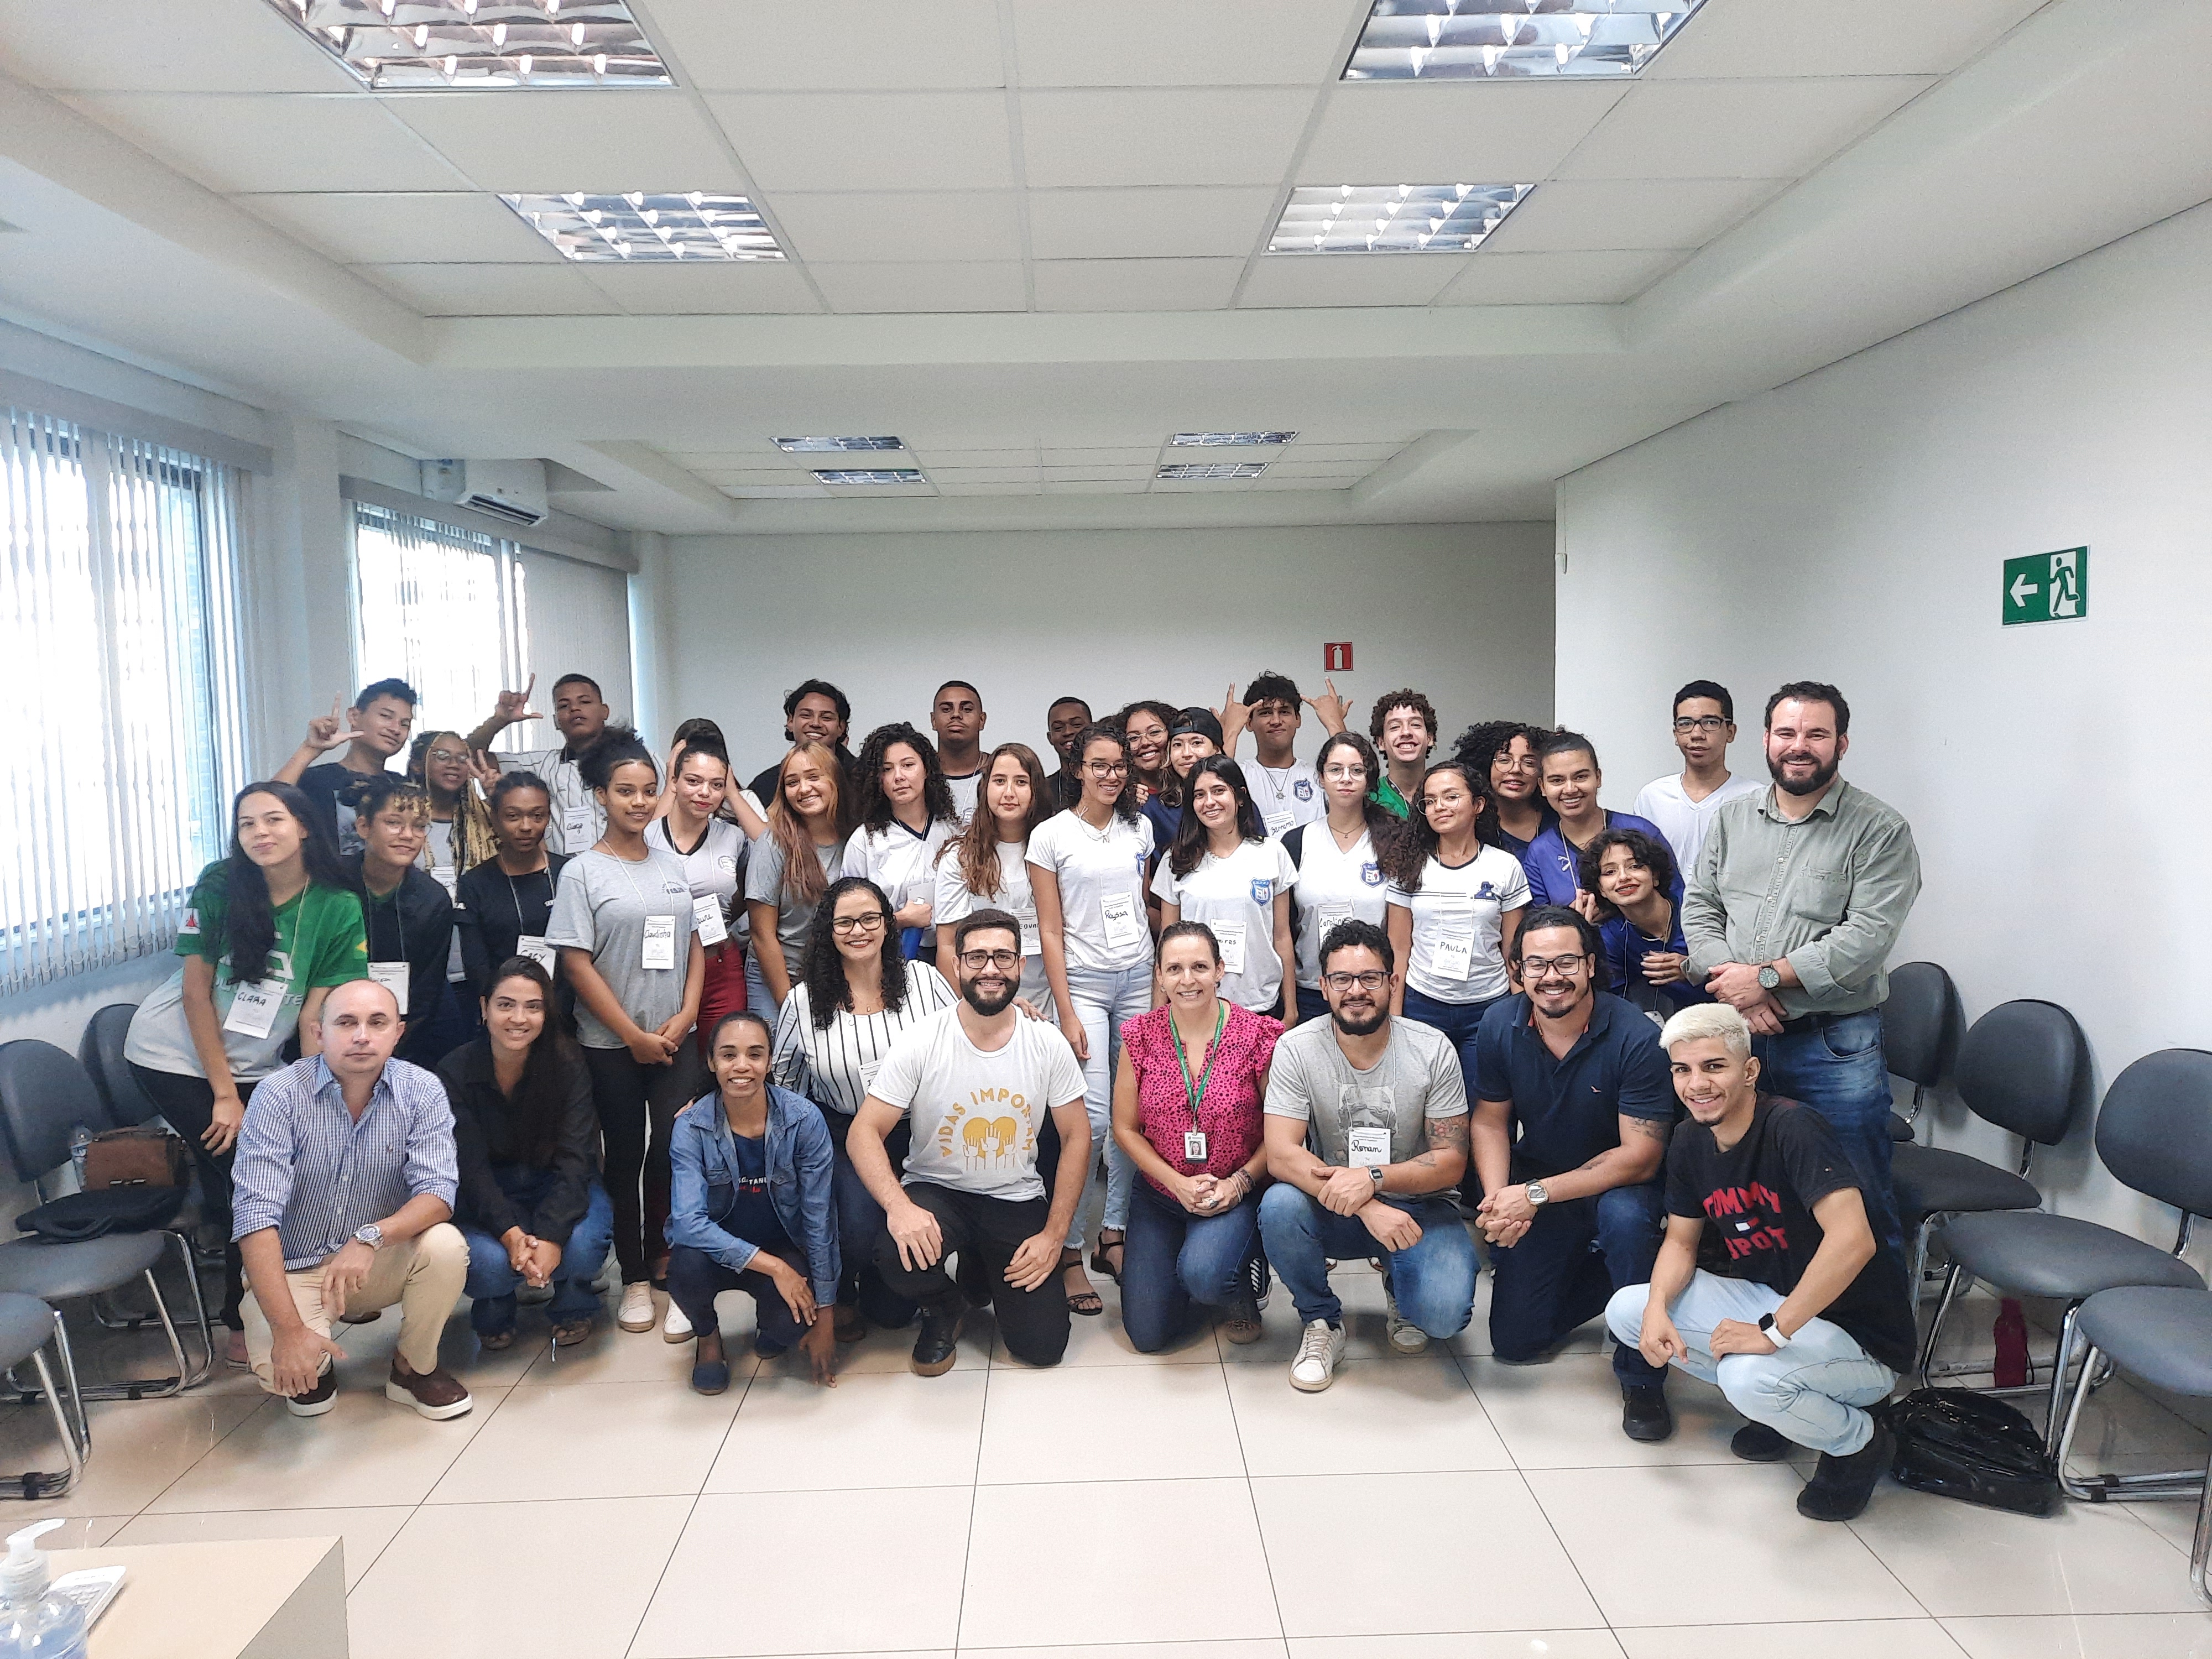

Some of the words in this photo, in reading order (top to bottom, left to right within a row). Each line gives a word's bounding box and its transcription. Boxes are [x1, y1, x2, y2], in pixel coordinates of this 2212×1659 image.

[1440, 941, 1467, 954] PAULA
[238, 992, 267, 1006] CLARA
[938, 1102, 966, 1157] VIDAS
[970, 1087, 1034, 1150] IMPORAM
[1351, 1139, 1383, 1153] Renan
